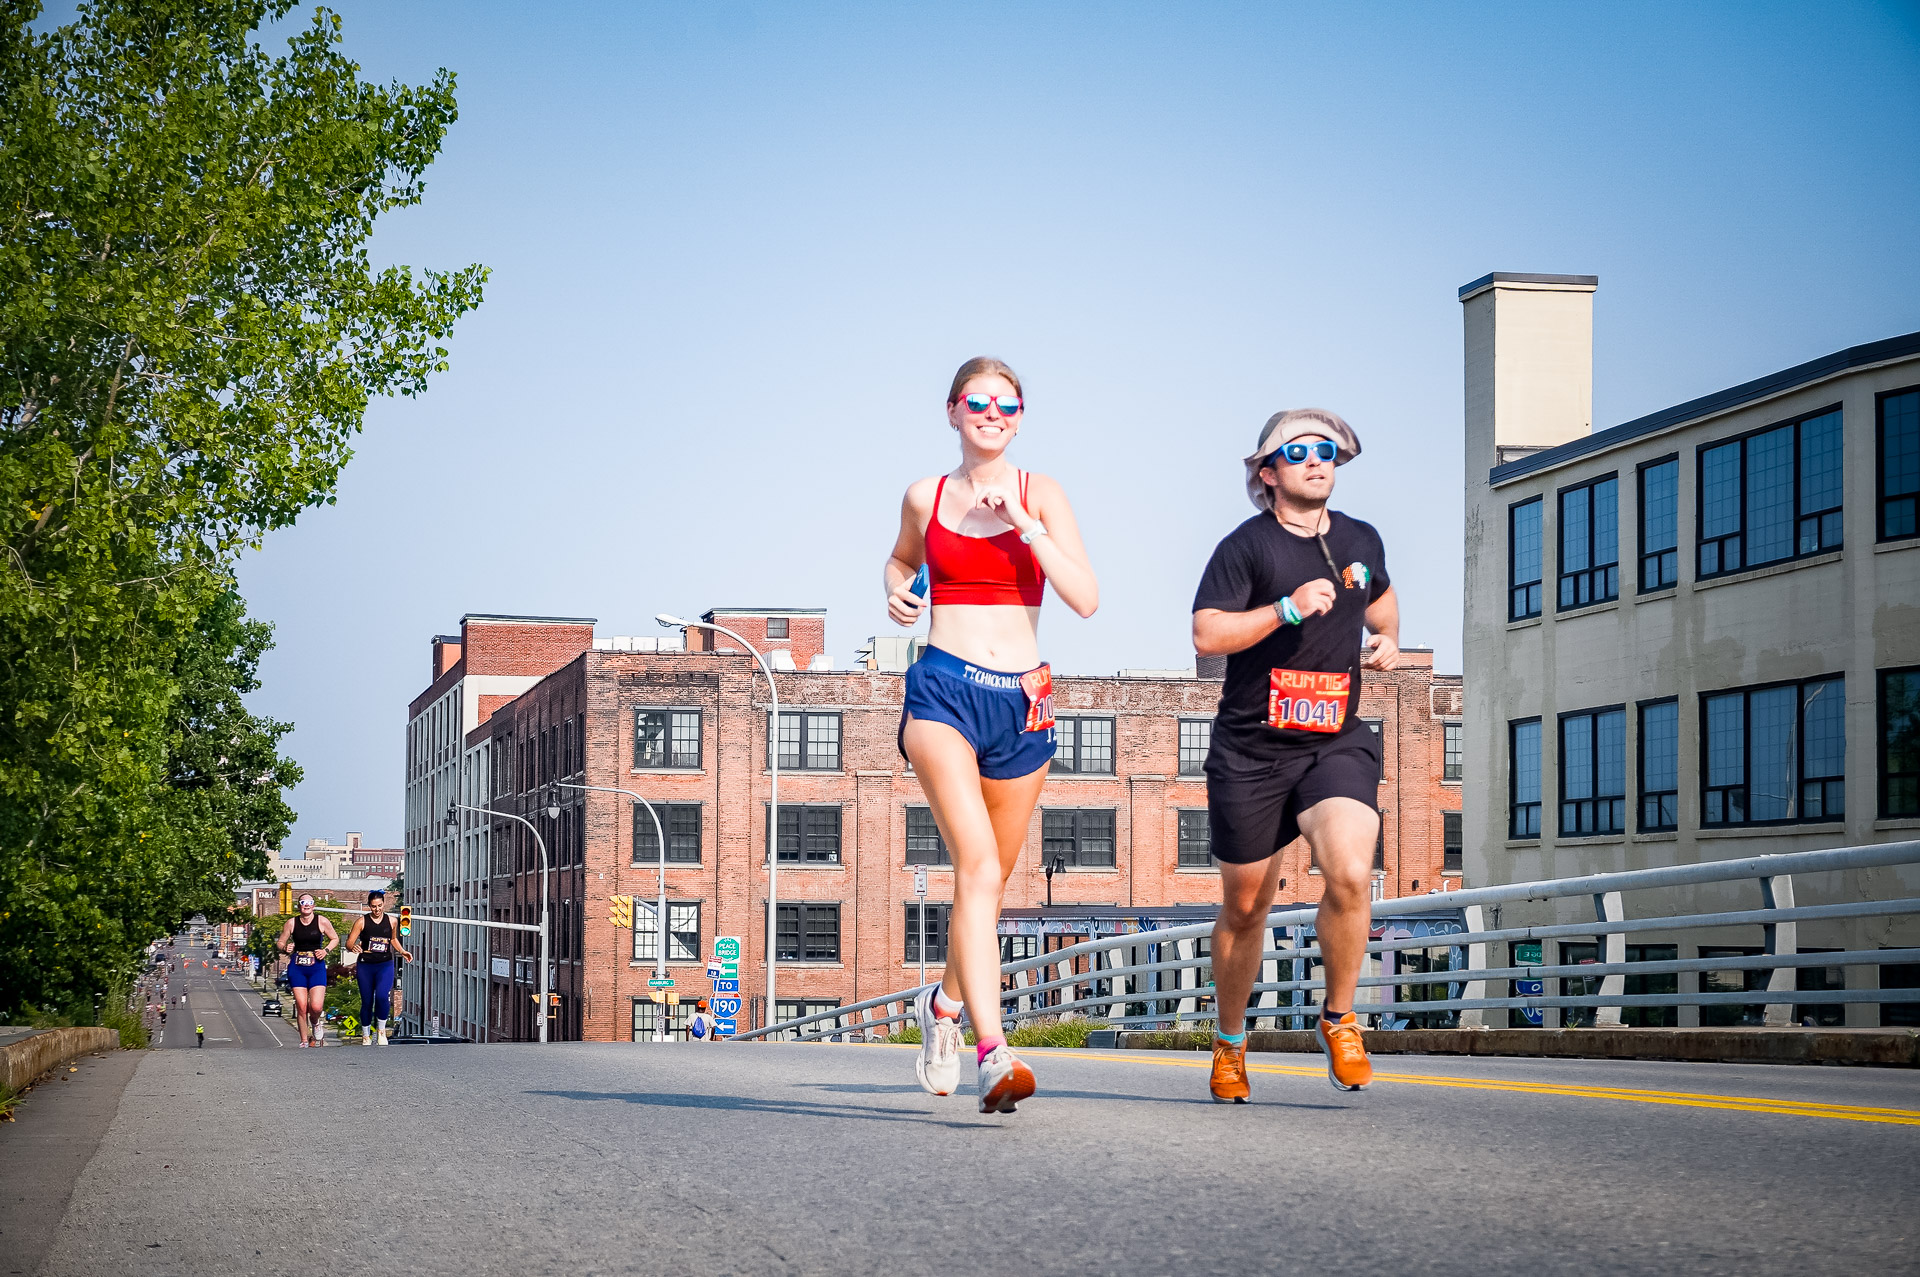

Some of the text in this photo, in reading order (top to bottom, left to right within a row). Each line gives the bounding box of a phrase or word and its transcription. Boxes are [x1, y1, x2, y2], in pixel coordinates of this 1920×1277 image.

[1280, 672, 1342, 690] RUN 716
[1278, 697, 1339, 726] 1041
[299, 957, 311, 965] 251
[715, 1000, 737, 1013] 190
